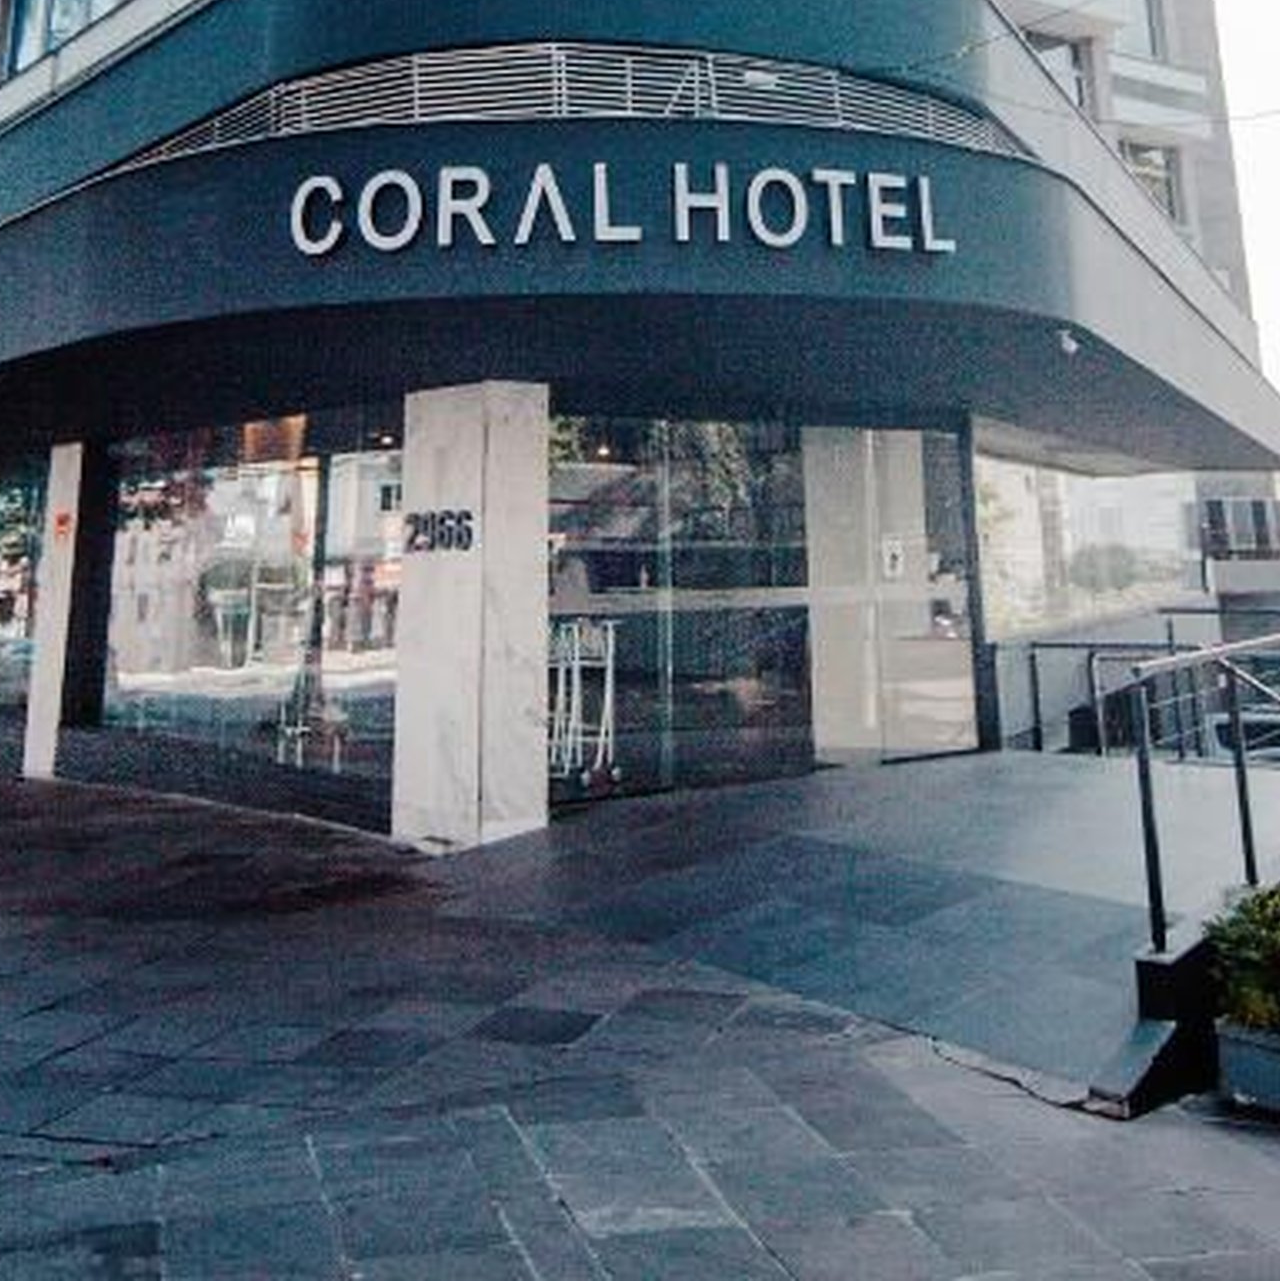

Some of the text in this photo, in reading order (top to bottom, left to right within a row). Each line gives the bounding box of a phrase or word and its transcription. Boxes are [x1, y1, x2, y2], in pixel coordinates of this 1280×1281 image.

[290, 162, 957, 255] CORAL HOTEL
[403, 509, 474, 554] 2966
